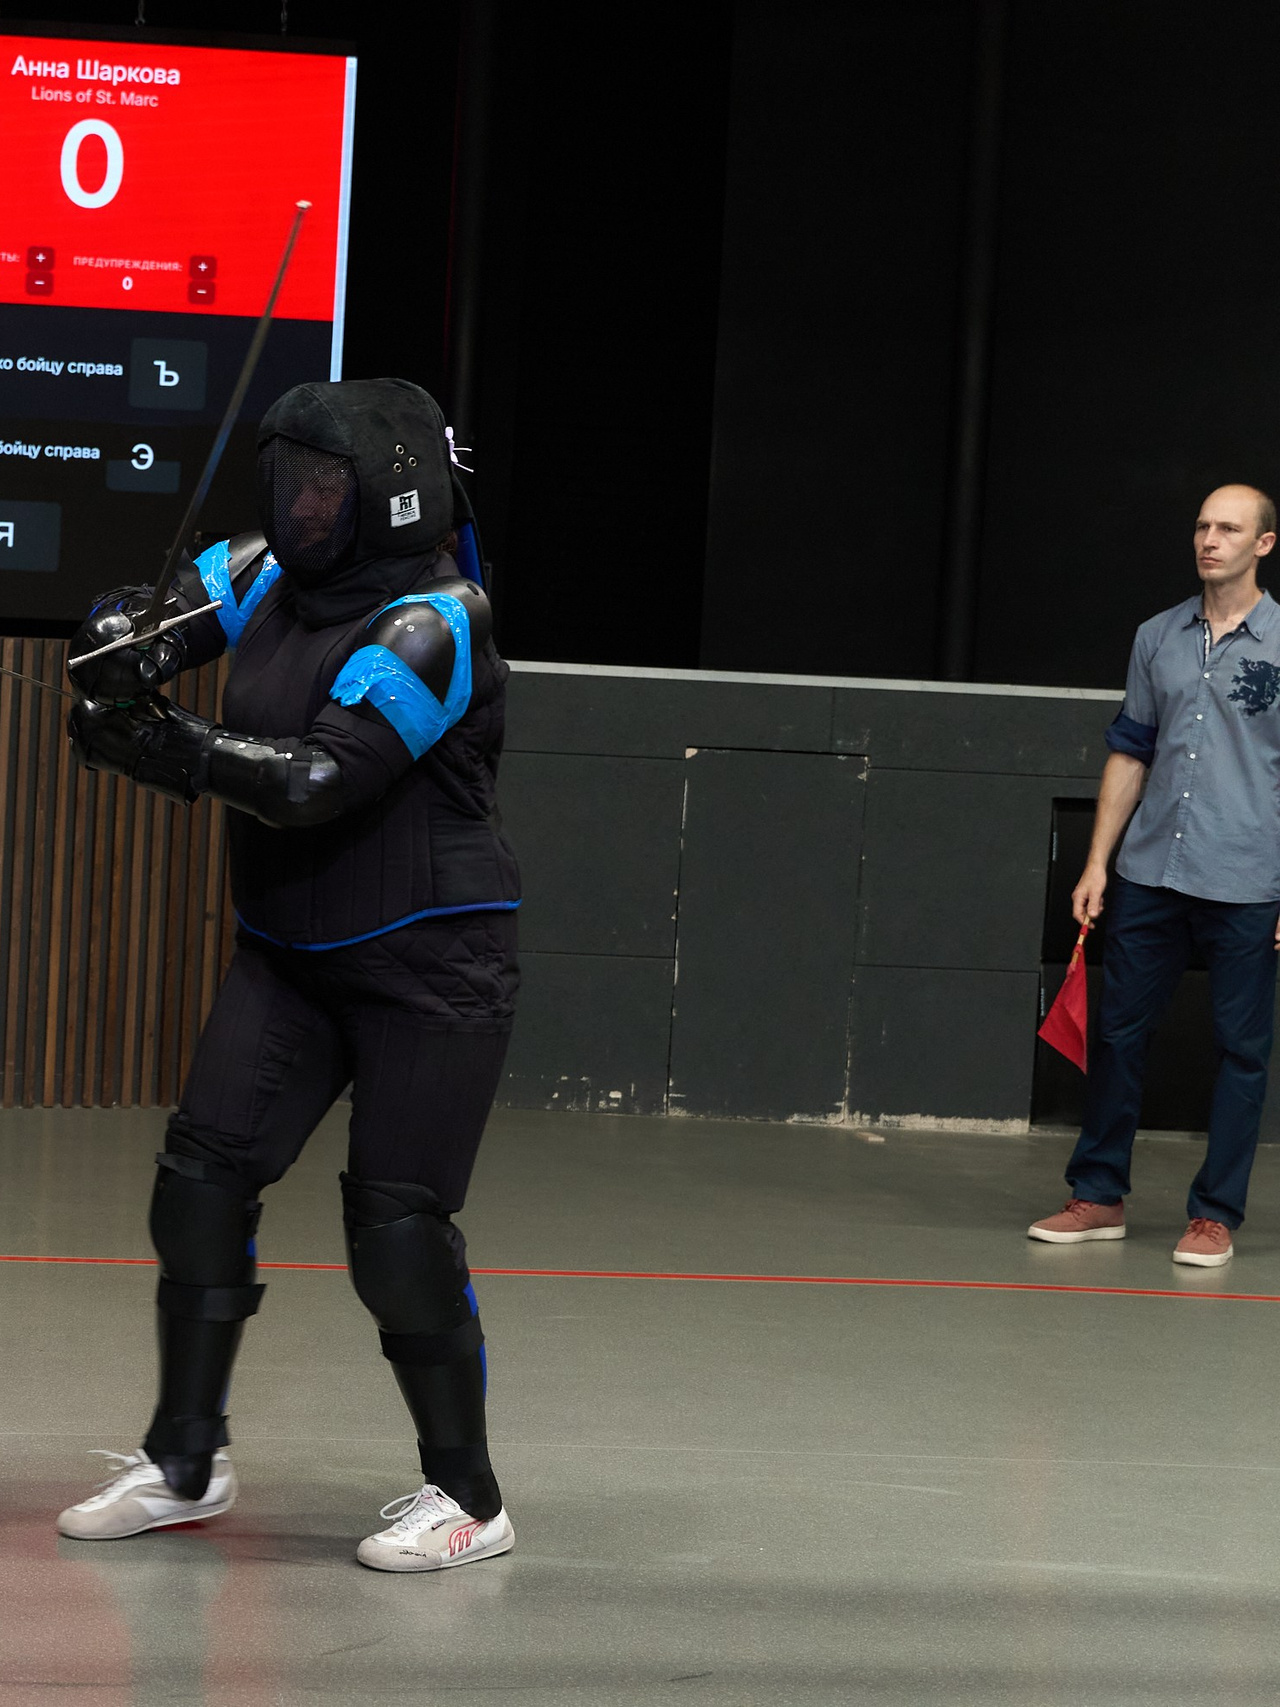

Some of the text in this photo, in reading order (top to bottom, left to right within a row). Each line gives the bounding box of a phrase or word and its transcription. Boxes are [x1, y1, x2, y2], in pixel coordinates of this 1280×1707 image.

[11, 55, 180, 86] Анна Шаркова
[31, 86, 159, 107] Lions of St. Marc
[59, 118, 124, 209] 0
[73, 256, 183, 272] ПРЕДУПРЕЖДЕНИЯ:
[121, 276, 134, 291] 0
[17, 356, 64, 376] бойцу
[67, 361, 123, 378] справа
[153, 360, 180, 387] Ъ
[44, 444, 101, 460] справа
[130, 443, 155, 470] Э
